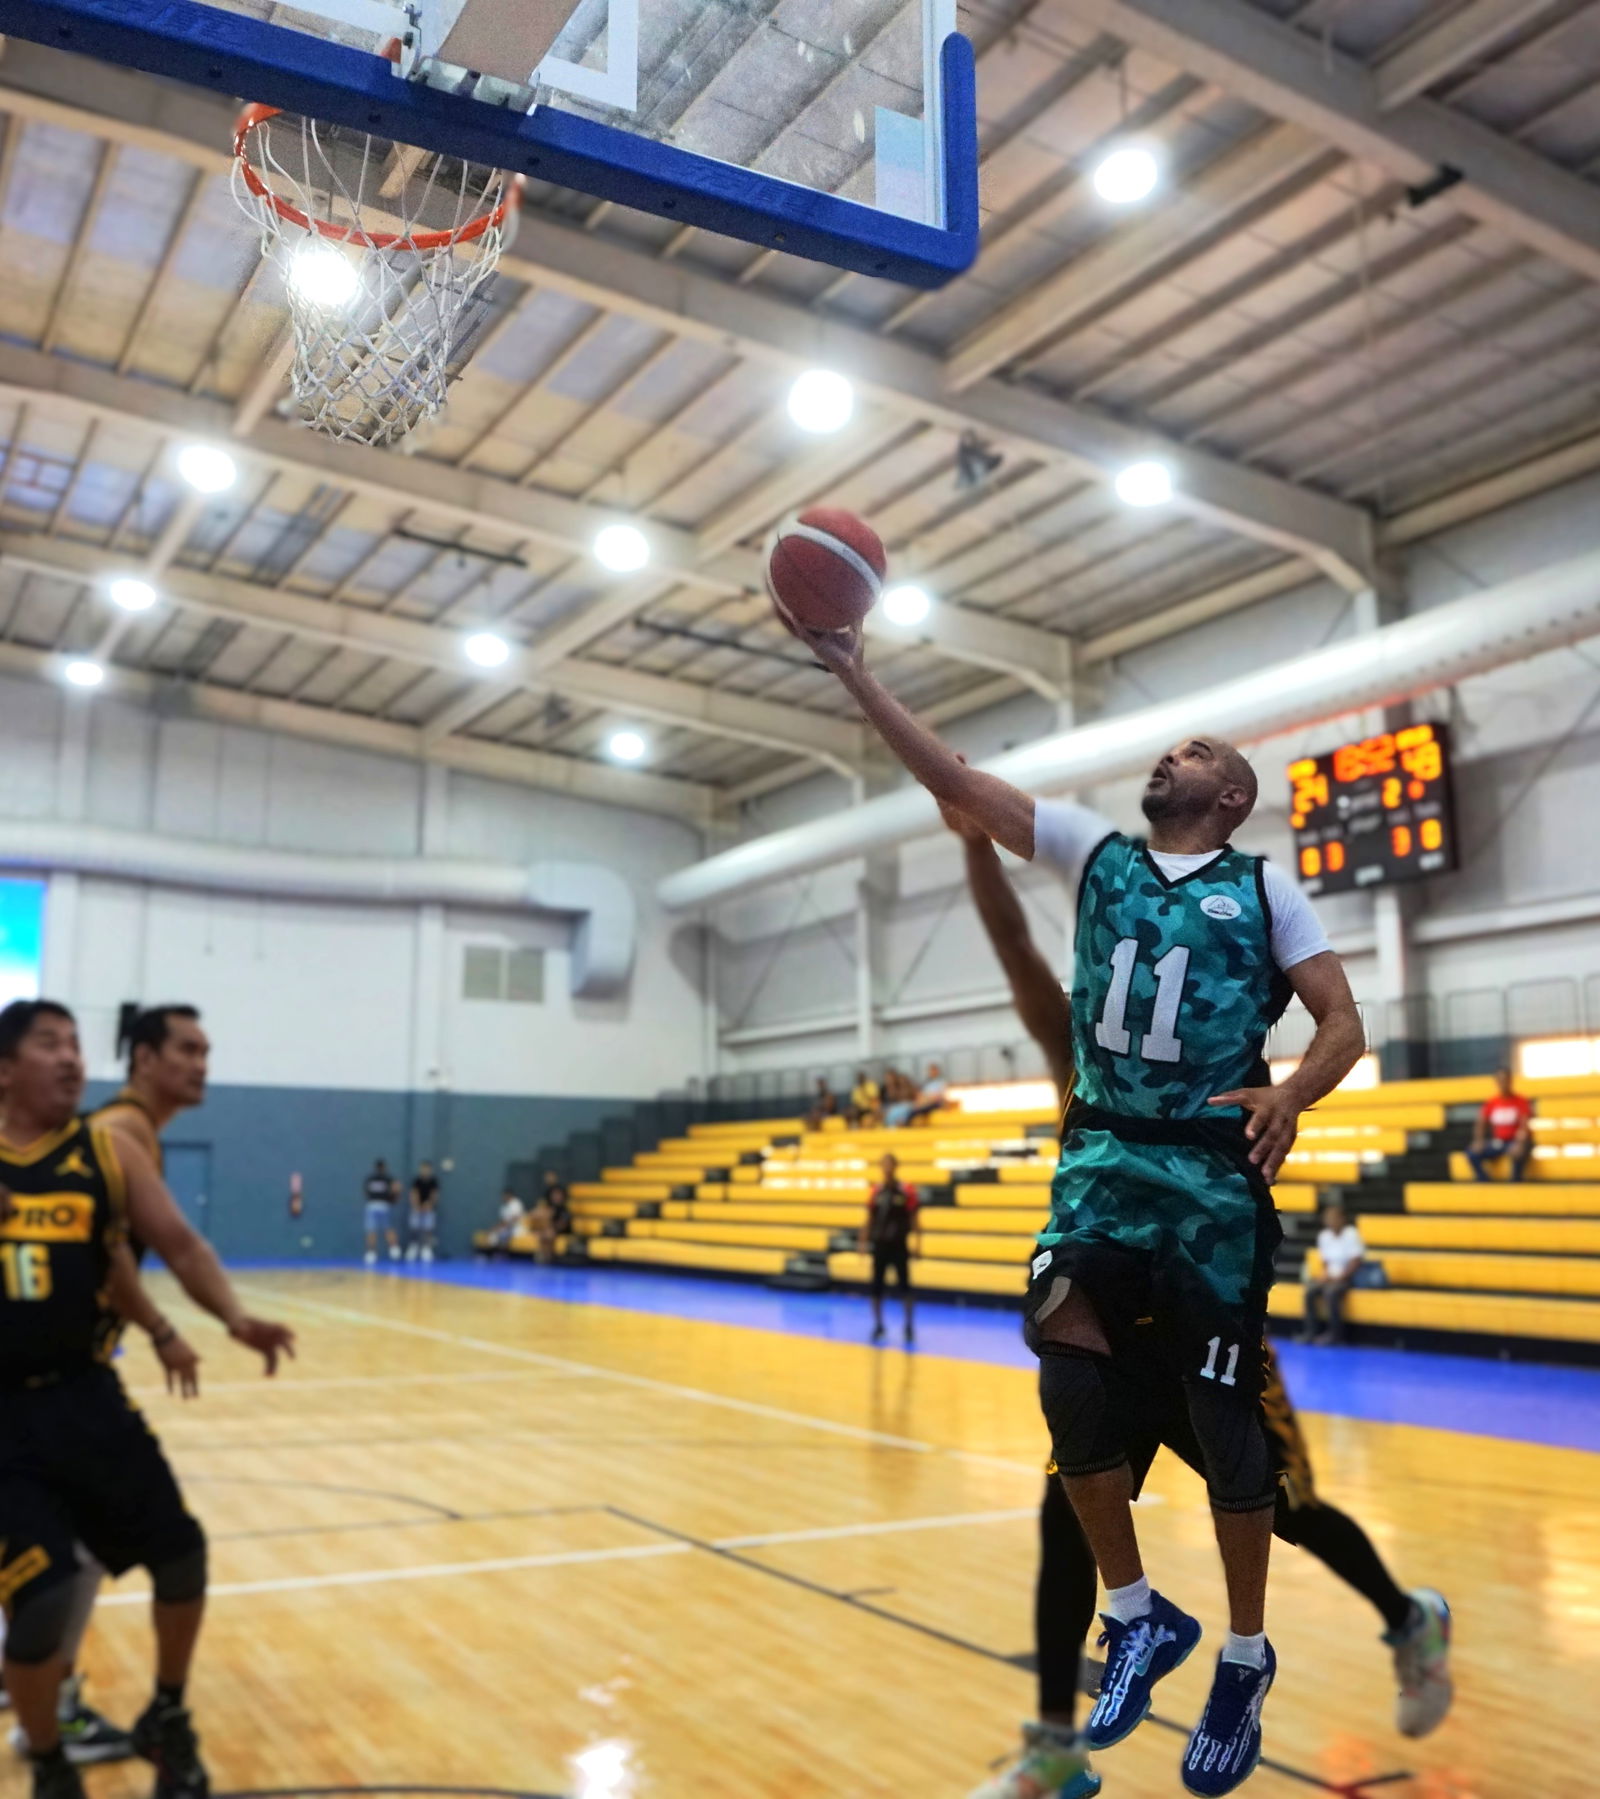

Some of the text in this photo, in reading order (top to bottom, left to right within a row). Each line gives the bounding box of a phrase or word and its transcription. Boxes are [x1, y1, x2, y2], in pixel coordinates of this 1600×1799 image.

[1095, 936, 1190, 1063] 11
[0, 1244, 51, 1300] 16
[1199, 1335, 1240, 1387] 11
